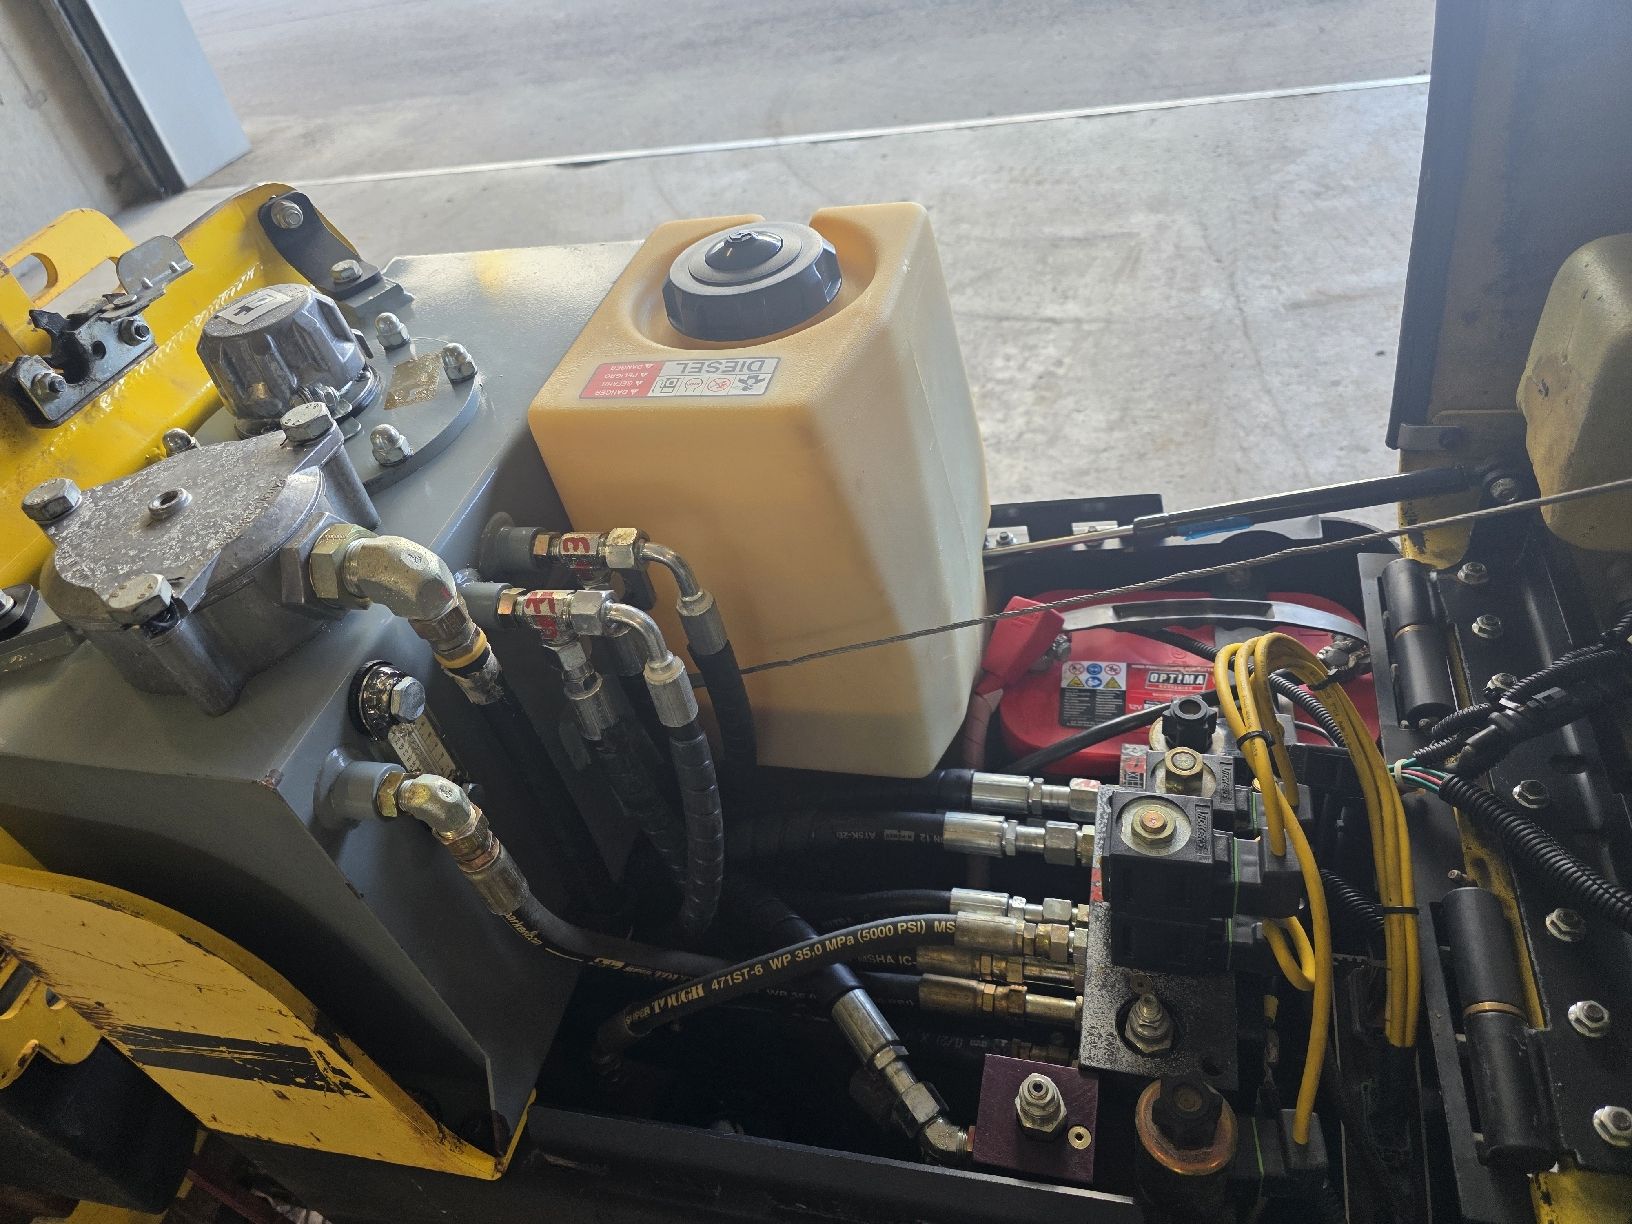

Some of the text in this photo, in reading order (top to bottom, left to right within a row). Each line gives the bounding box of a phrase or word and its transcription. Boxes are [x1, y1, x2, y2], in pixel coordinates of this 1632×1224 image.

[676, 360, 765, 374] DIESEL
[595, 388, 629, 396] DANGER
[1150, 673, 1205, 685] OPTIMA
[711, 965, 764, 991] 471ST-6
[770, 954, 792, 971] WP
[795, 944, 823, 963] 35.0
[825, 935, 855, 952] MPa
[857, 925, 894, 944] (5000
[897, 919, 926, 935] PSI)
[934, 920, 957, 934] MS
